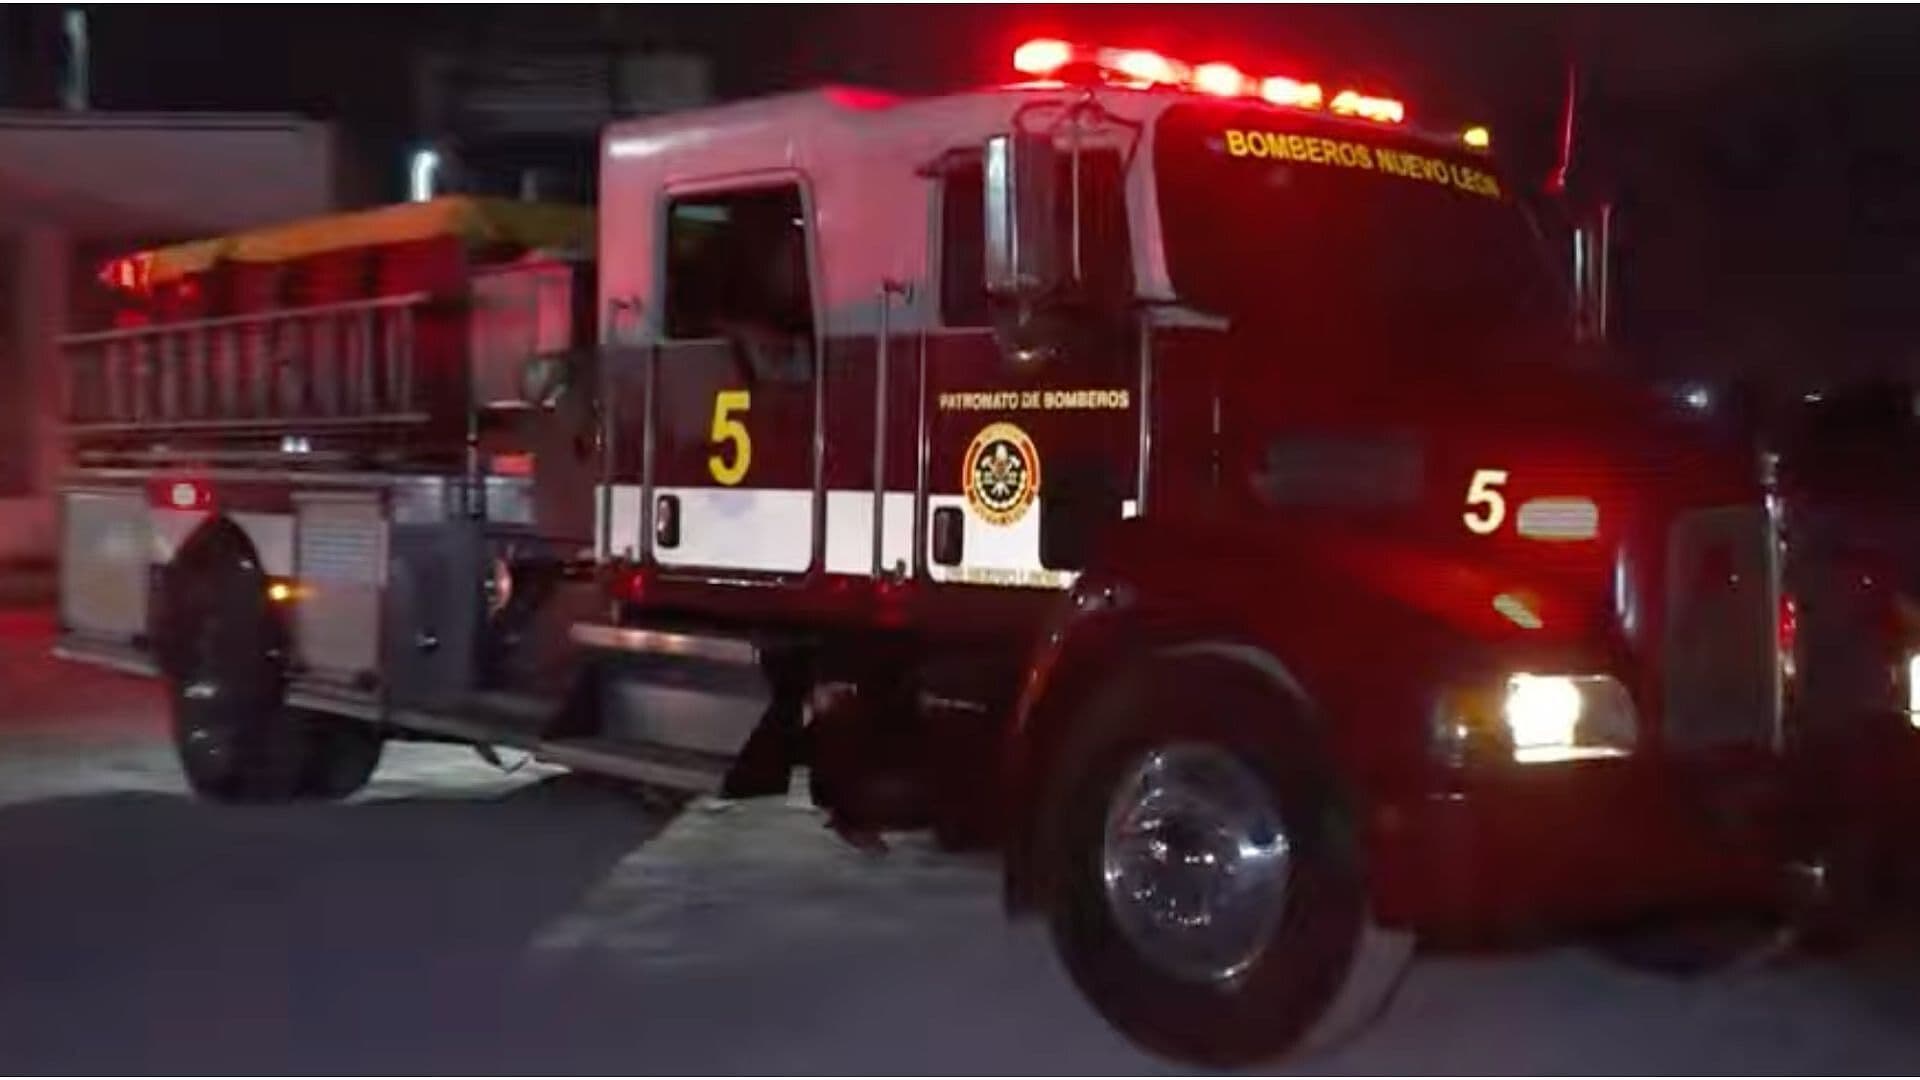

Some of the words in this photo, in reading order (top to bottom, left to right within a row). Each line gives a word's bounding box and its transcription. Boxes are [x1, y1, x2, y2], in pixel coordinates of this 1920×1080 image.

[1226, 130, 1374, 169] BOMBEROS
[1376, 149, 1450, 184] NUEVO
[939, 391, 1019, 411] PATRONATO
[1021, 391, 1041, 409] DE
[1043, 389, 1130, 409] BOMBEROS
[709, 390, 751, 486] 5
[1463, 469, 1509, 534] 5
